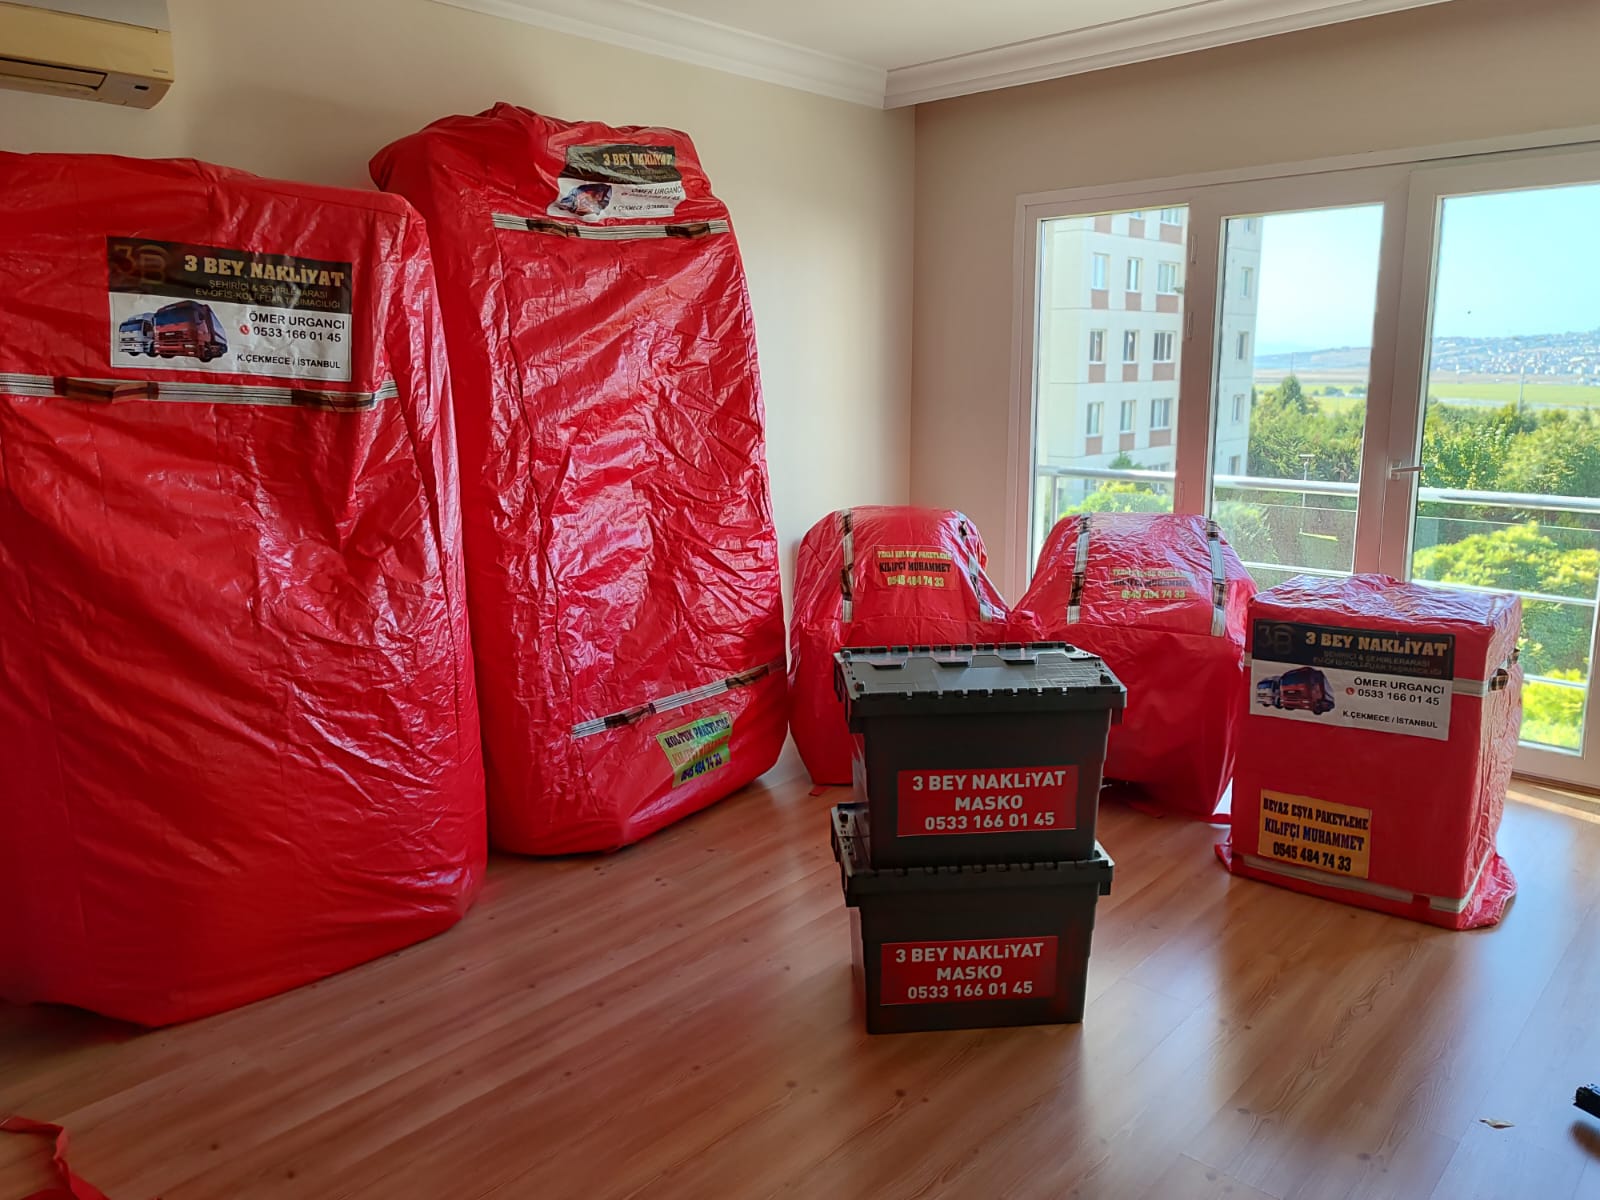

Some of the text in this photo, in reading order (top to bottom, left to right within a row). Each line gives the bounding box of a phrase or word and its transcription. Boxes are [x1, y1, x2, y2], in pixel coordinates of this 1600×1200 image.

[602, 152, 610, 166] 3
[612, 153, 630, 166] BEY
[184, 255, 345, 287] 3 BEY NAKLİYAT
[249, 311, 345, 330] ÖMER URGANCI
[253, 326, 341, 343] 0533 166 01 45
[237, 354, 291, 366] K.ÇEKMECE
[297, 356, 340, 369] İSTANBUL
[1306, 631, 1448, 657] 3 BEY NAKLİYAT
[1358, 688, 1440, 706] 0533 166 01 45
[1390, 681, 1445, 695] URGANCI
[1342, 710, 1390, 723] K.ÇEKMECE
[1396, 715, 1438, 729] İSTANBUL
[912, 776, 924, 791] 3
[929, 774, 967, 791] BEY
[955, 794, 1024, 812] MASKO
[925, 811, 1055, 831] 0533 166 01 45
[1263, 798, 1369, 830] BEYAZ EŞYA PAKETLEME
[1303, 826, 1365, 851] MUHAMMET
[1273, 841, 1352, 872] 0545 484 74 33
[895, 949, 906, 963] 3
[911, 947, 948, 962] BEY
[936, 965, 1003, 981] MASKO
[907, 981, 1033, 999] 0533 166 01 45
